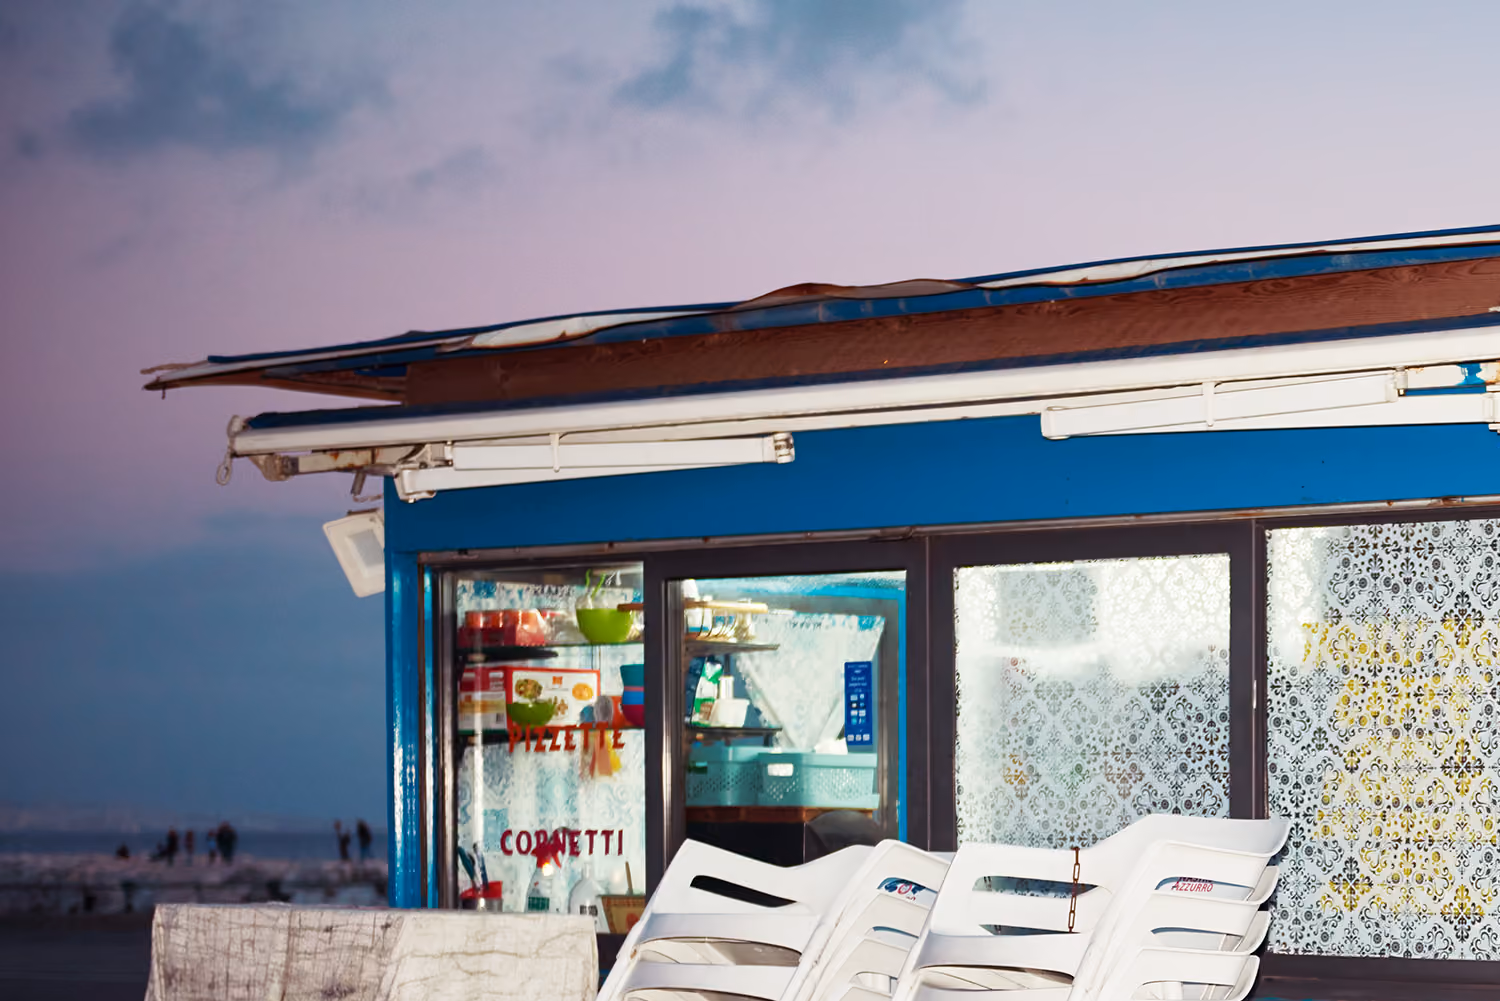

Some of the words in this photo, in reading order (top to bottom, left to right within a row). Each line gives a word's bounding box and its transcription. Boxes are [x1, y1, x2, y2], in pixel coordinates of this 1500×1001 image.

[509, 723, 625, 753] PIZZETTE
[500, 829, 623, 857] CORNETTI
[1171, 881, 1213, 892] AZZURRO
